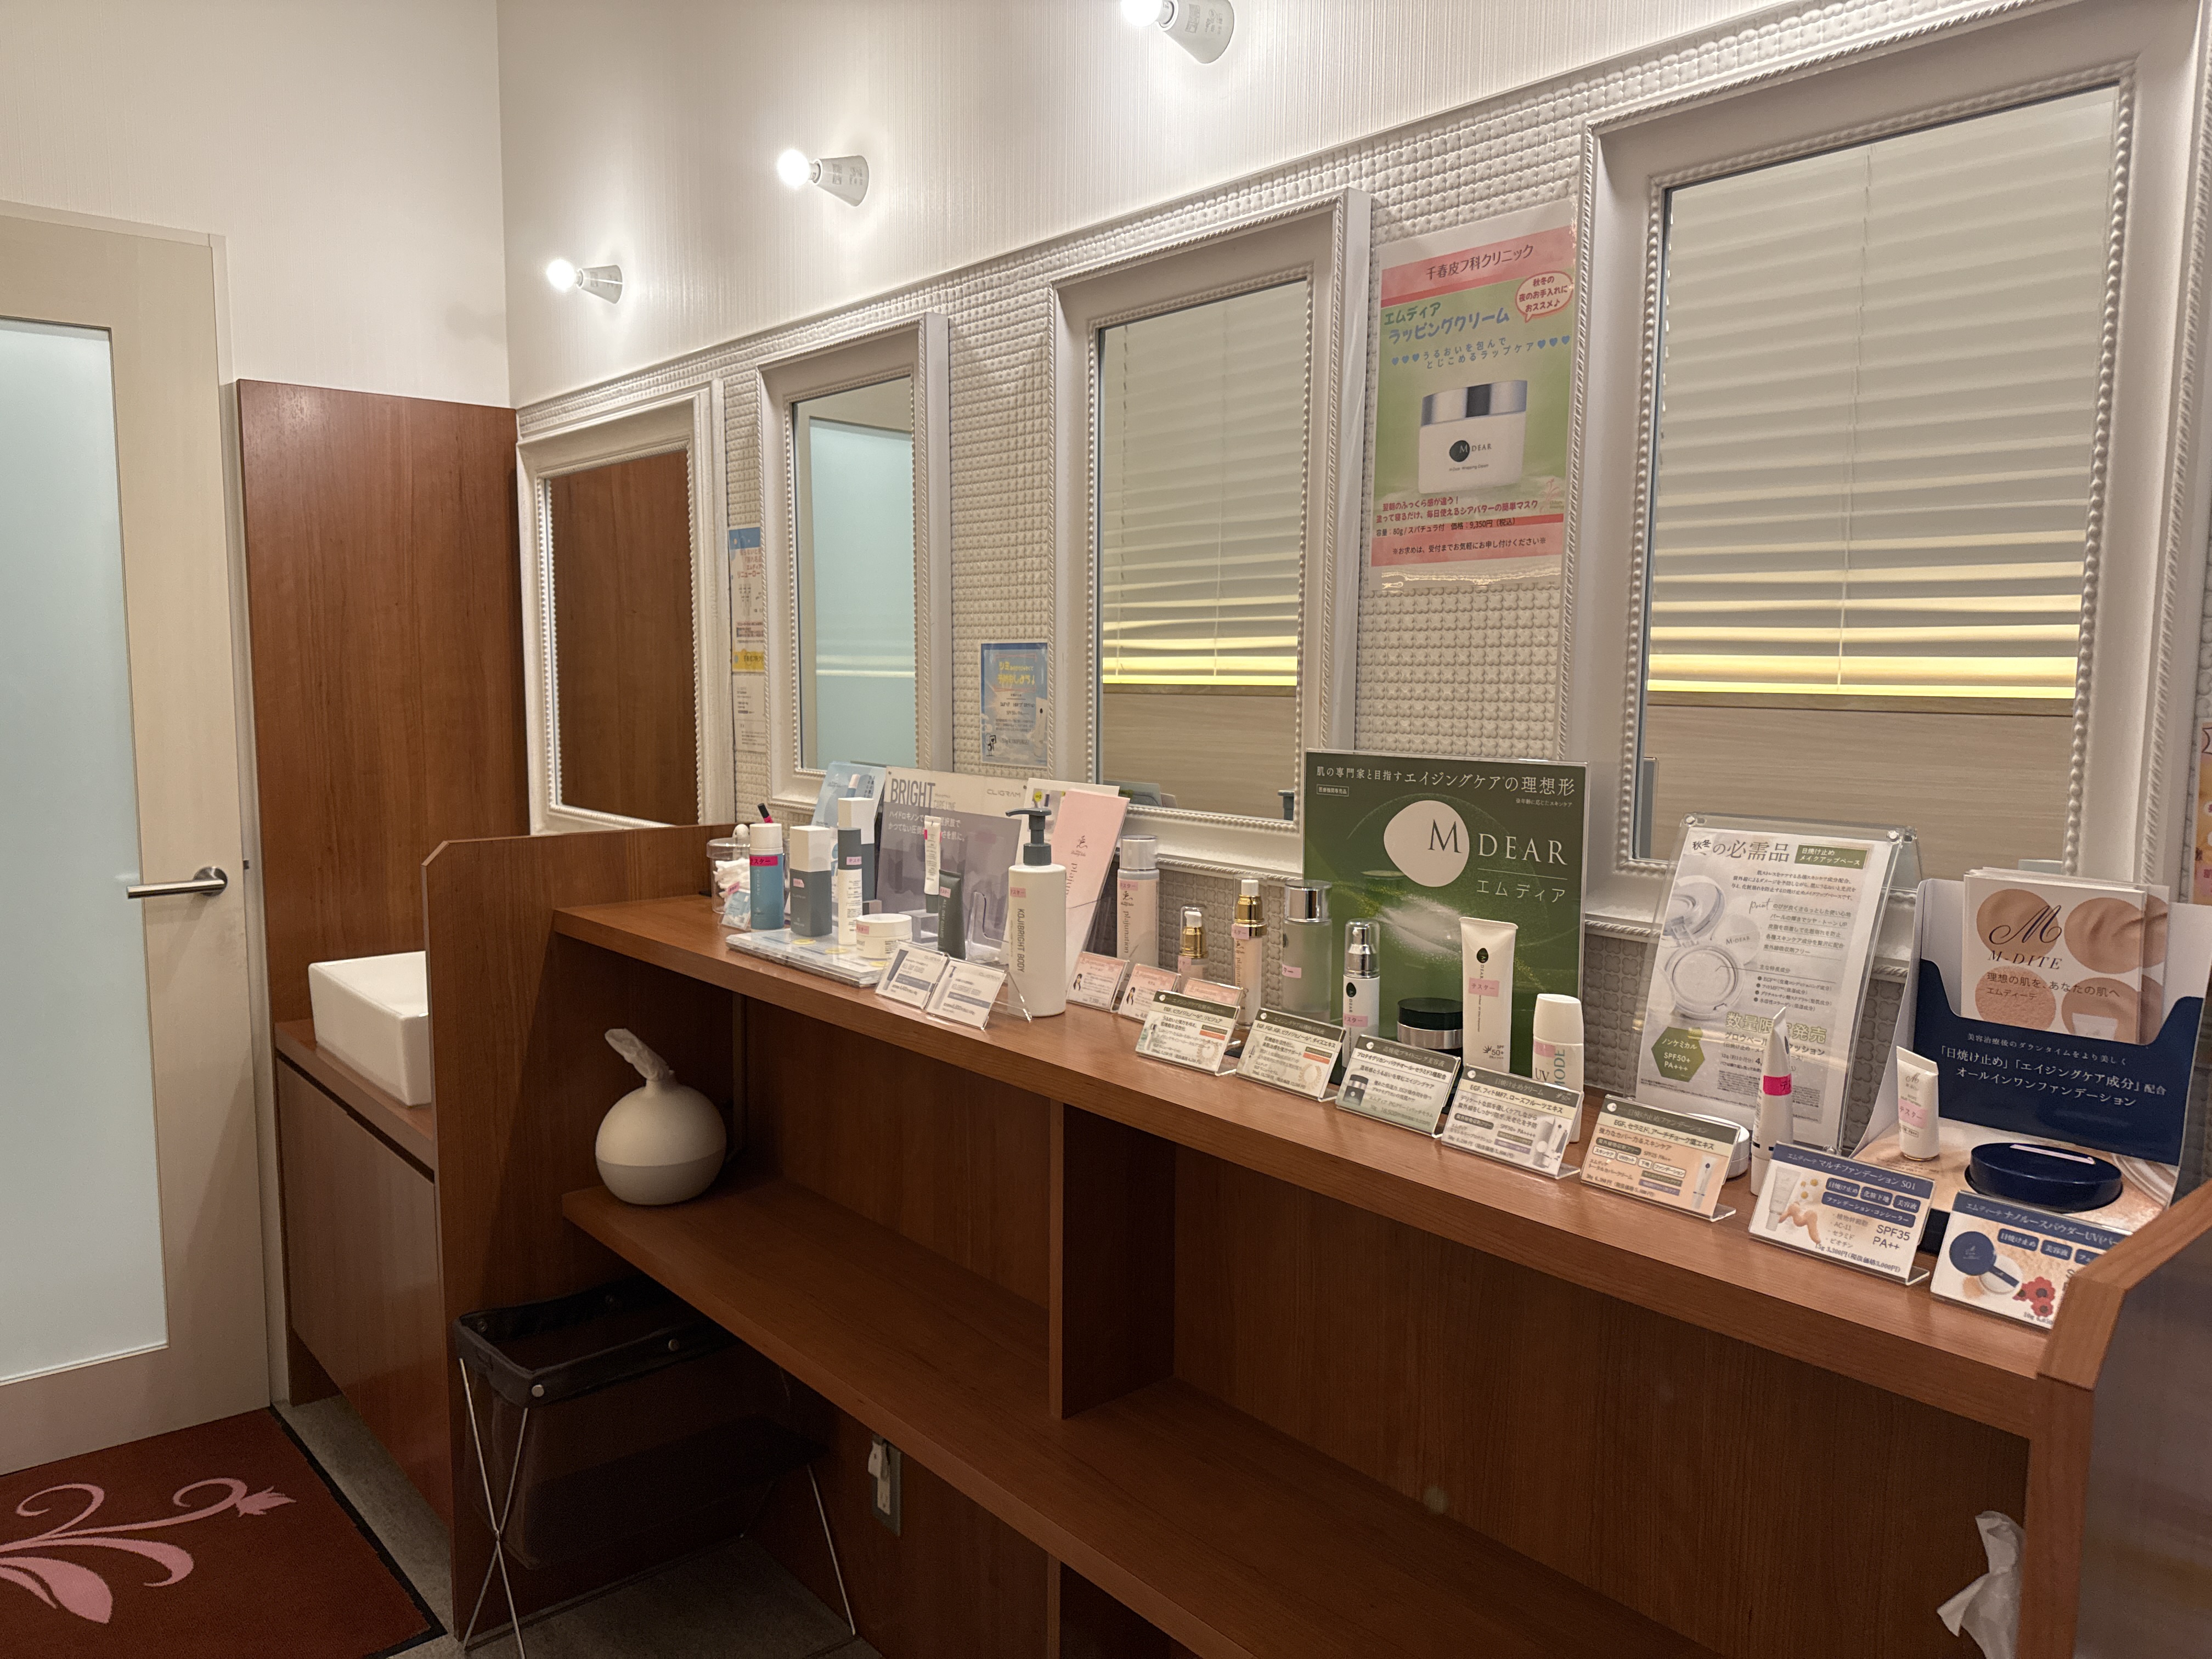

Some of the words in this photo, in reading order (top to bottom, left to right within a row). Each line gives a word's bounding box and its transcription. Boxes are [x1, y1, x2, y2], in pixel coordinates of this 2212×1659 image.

[1425, 244, 1534, 281] 千春皮フ科クリニック
[1532, 275, 1555, 286] 秋冬の
[1519, 285, 1568, 302] 夜のお手入れに
[1384, 301, 1441, 326] エムディア
[1388, 307, 1510, 345] ラッピングクリーム
[1423, 336, 1508, 360] うるおいを包んで
[1426, 342, 1534, 370] とじこめるラップケア
[1471, 443, 1492, 452] DEAR
[889, 777, 936, 807] BRIGHT
[986, 788, 1021, 798] CLIGRAM
[1427, 819, 1463, 854] M
[1477, 832, 1568, 865] DEAR
[1801, 847, 1836, 856] 日焼け止め
[1798, 855, 1861, 866] メイクアップベース
[1476, 879, 1566, 904] エムディア
[1987, 950, 2063, 970] M-DITE
[1471, 983, 1496, 991] テスター
[1987, 971, 2121, 998] 理想の肌を、あなたの肌へ
[1987, 988, 2038, 1001] エムディーテ
[1661, 1037, 1697, 1050] ノンケミカル
[1967, 1031, 2128, 1065] 美容治療後のダウンタイムをより美しく
[1663, 1052, 1691, 1063] SPF50+
[1664, 1060, 1689, 1071] PA+++
[1534, 1067, 1550, 1082] UV
[1956, 1066, 2137, 1107] オールインワンファンデーション
[1899, 1105, 1923, 1120] テスター
[1818, 1159, 1899, 1186] マルチファンデーション
[1875, 1224, 1911, 1242] SPF35
[1872, 1236, 1900, 1251] PA++
